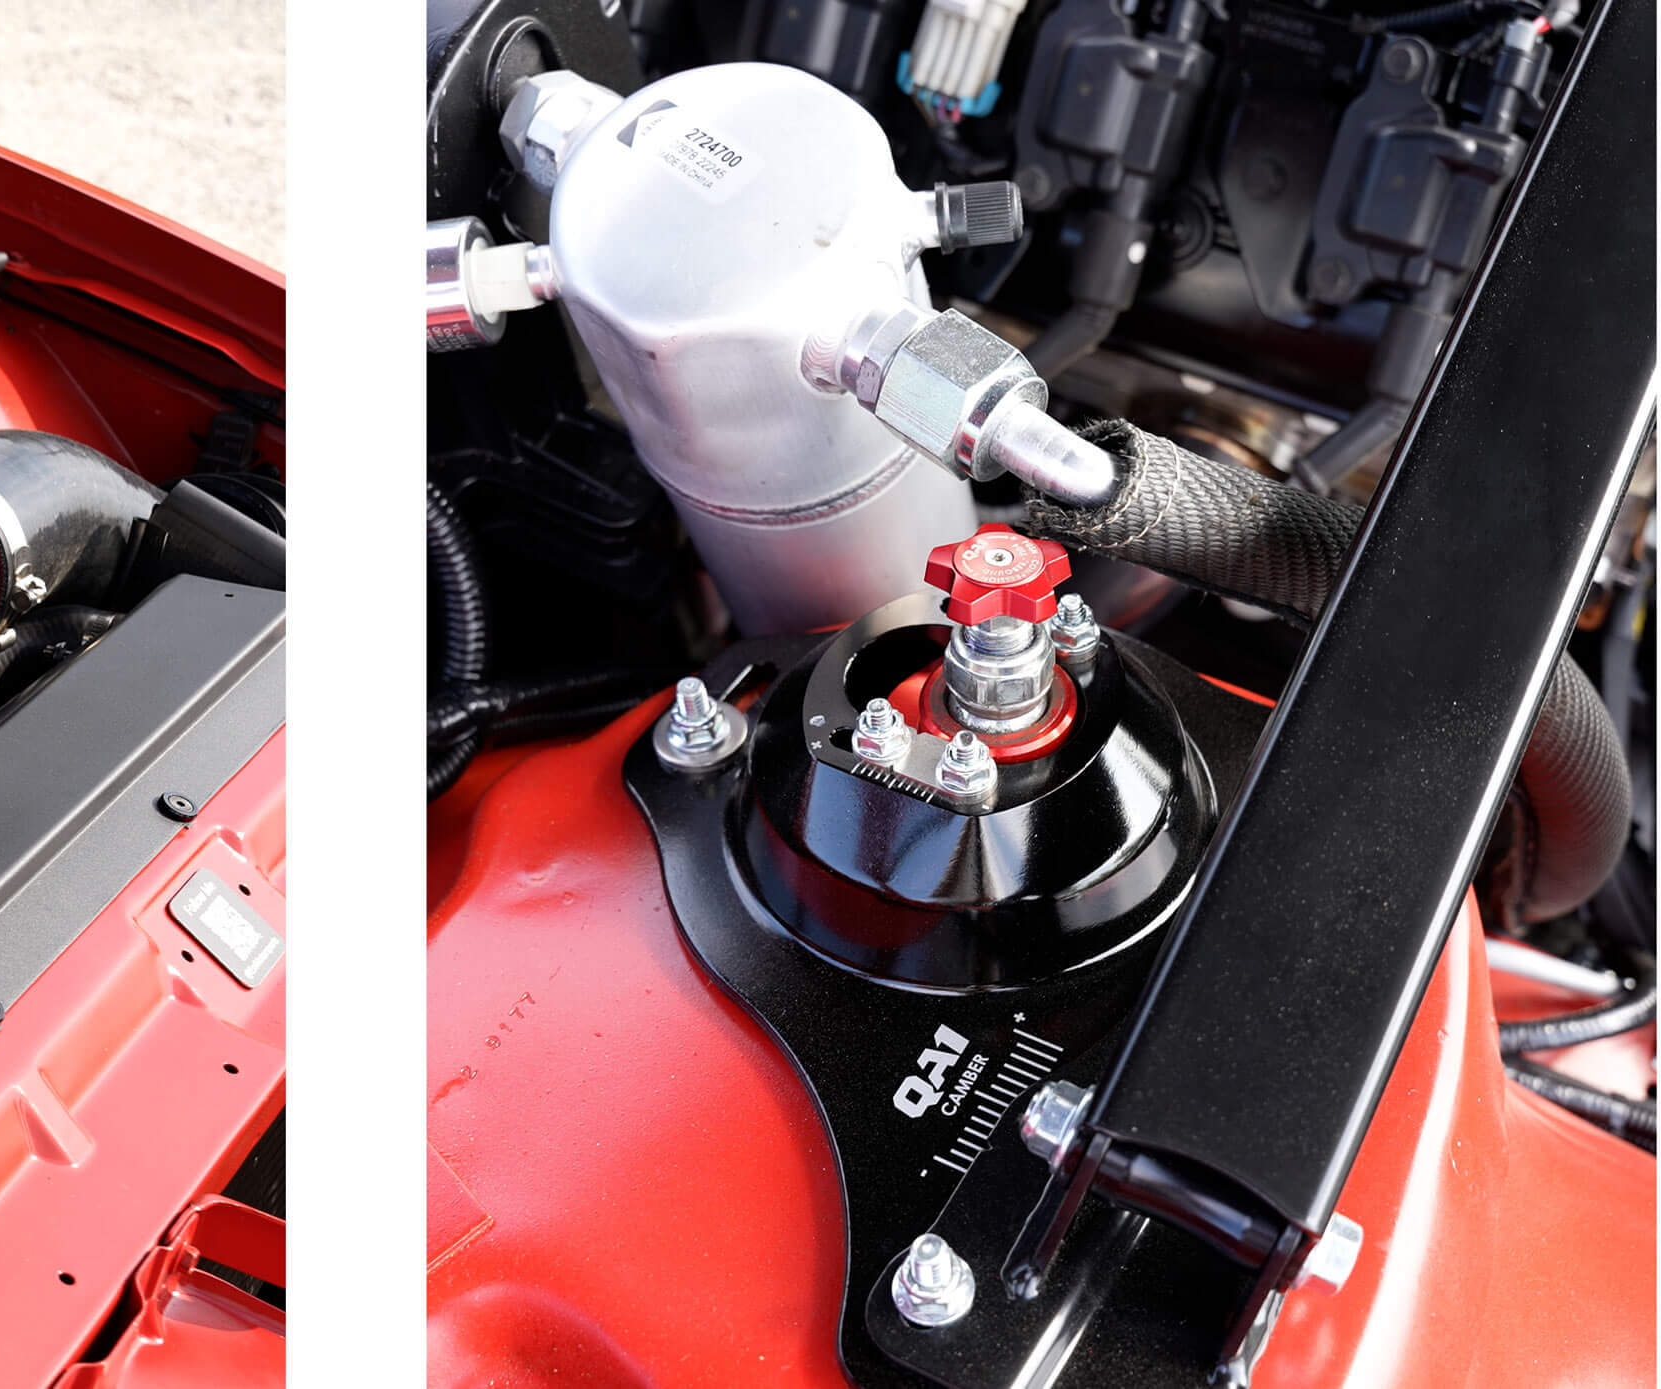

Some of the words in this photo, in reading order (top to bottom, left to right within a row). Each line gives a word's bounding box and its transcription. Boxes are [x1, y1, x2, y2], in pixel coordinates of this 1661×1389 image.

[684, 127, 743, 168] 2724700
[892, 1023, 970, 1119] QA1
[941, 1053, 990, 1116] CAMBER
